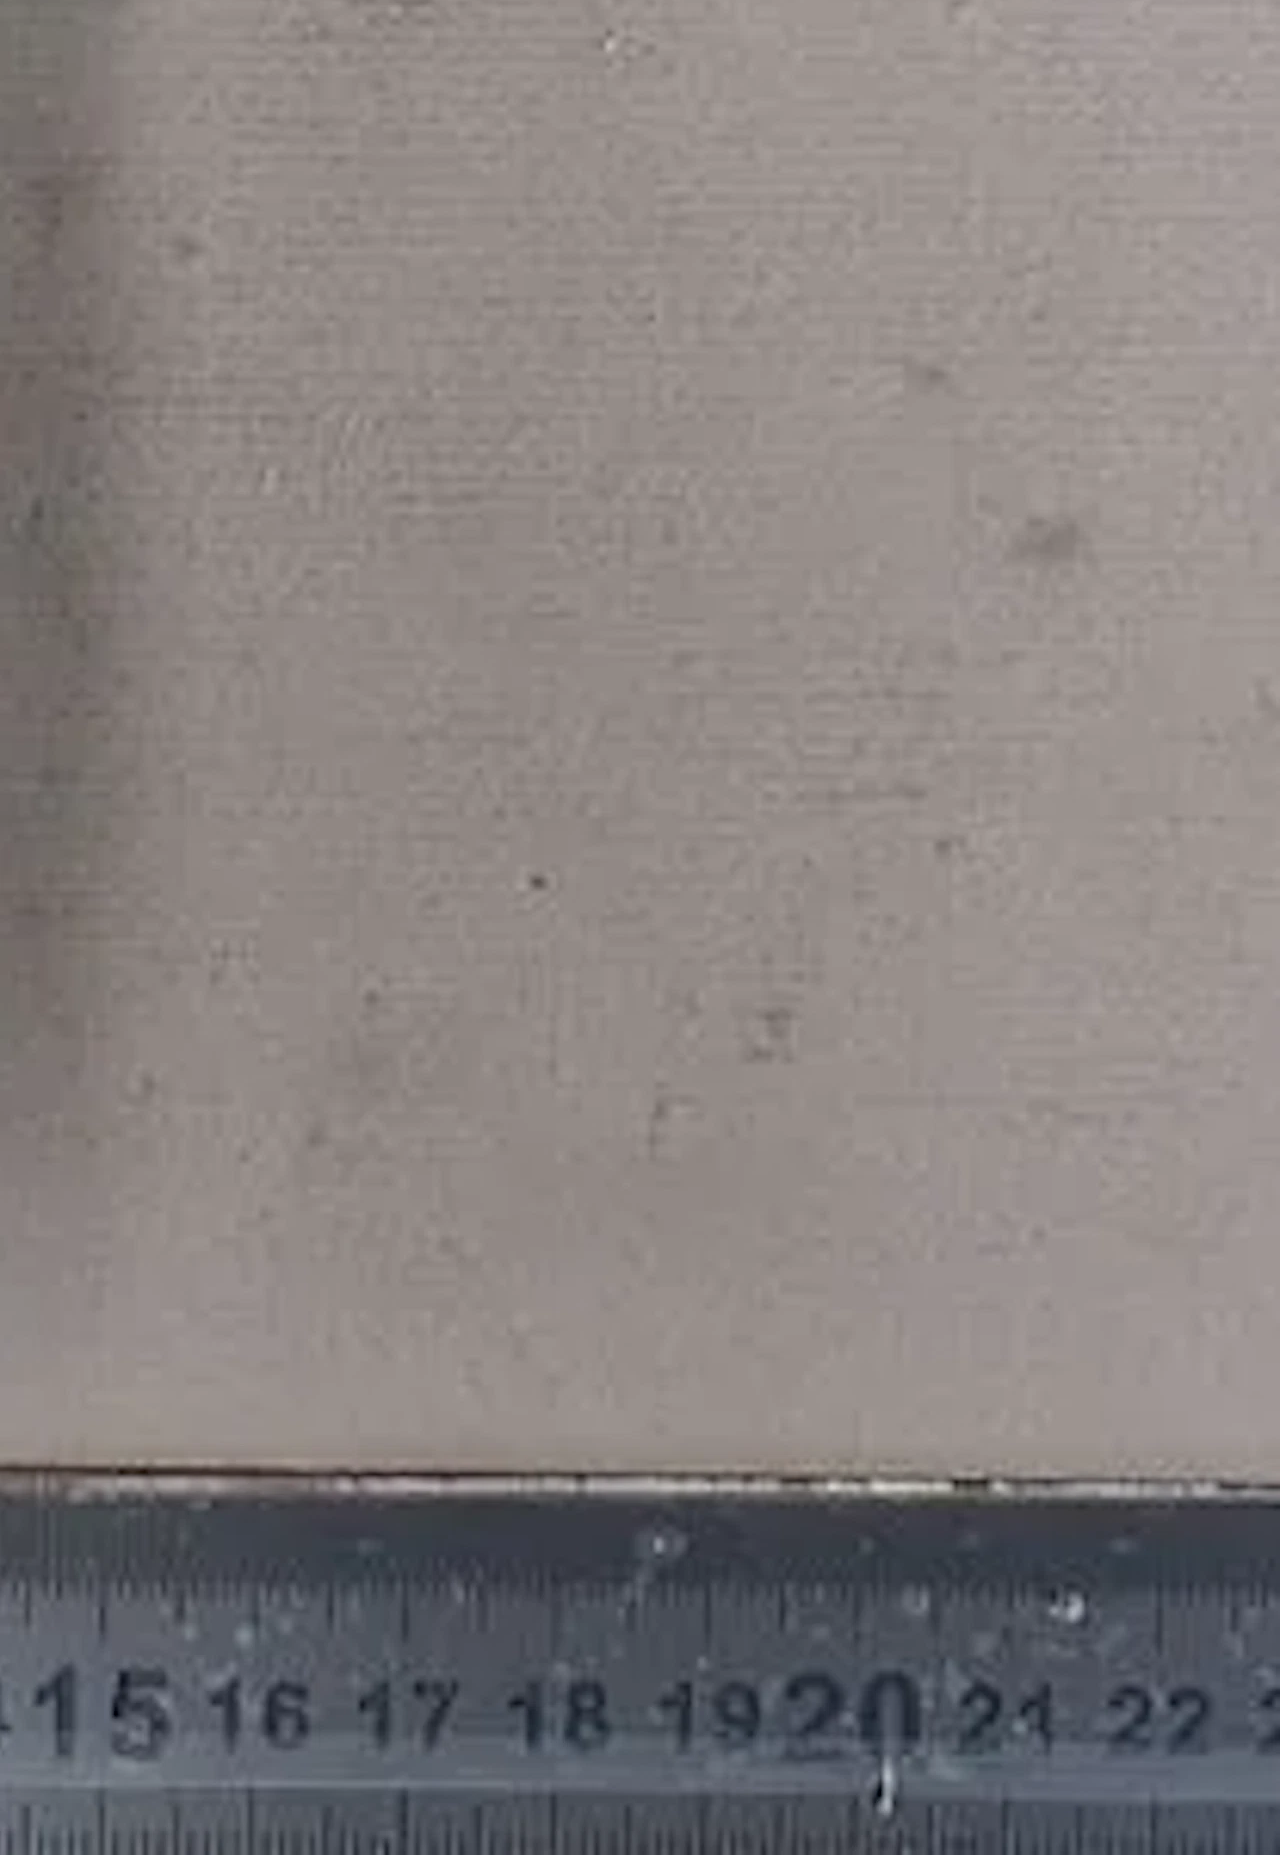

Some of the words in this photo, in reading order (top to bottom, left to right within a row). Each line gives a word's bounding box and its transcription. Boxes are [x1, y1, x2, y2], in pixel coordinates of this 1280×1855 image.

[35, 1667, 171, 1759] 15
[208, 1677, 311, 1750] 16
[358, 1681, 459, 1751] 17
[507, 1680, 611, 1752] 18
[657, 1680, 762, 1754] 19
[781, 1670, 922, 1768] 20
[958, 1680, 1055, 1754] 21
[1107, 1684, 1211, 1756] 22
